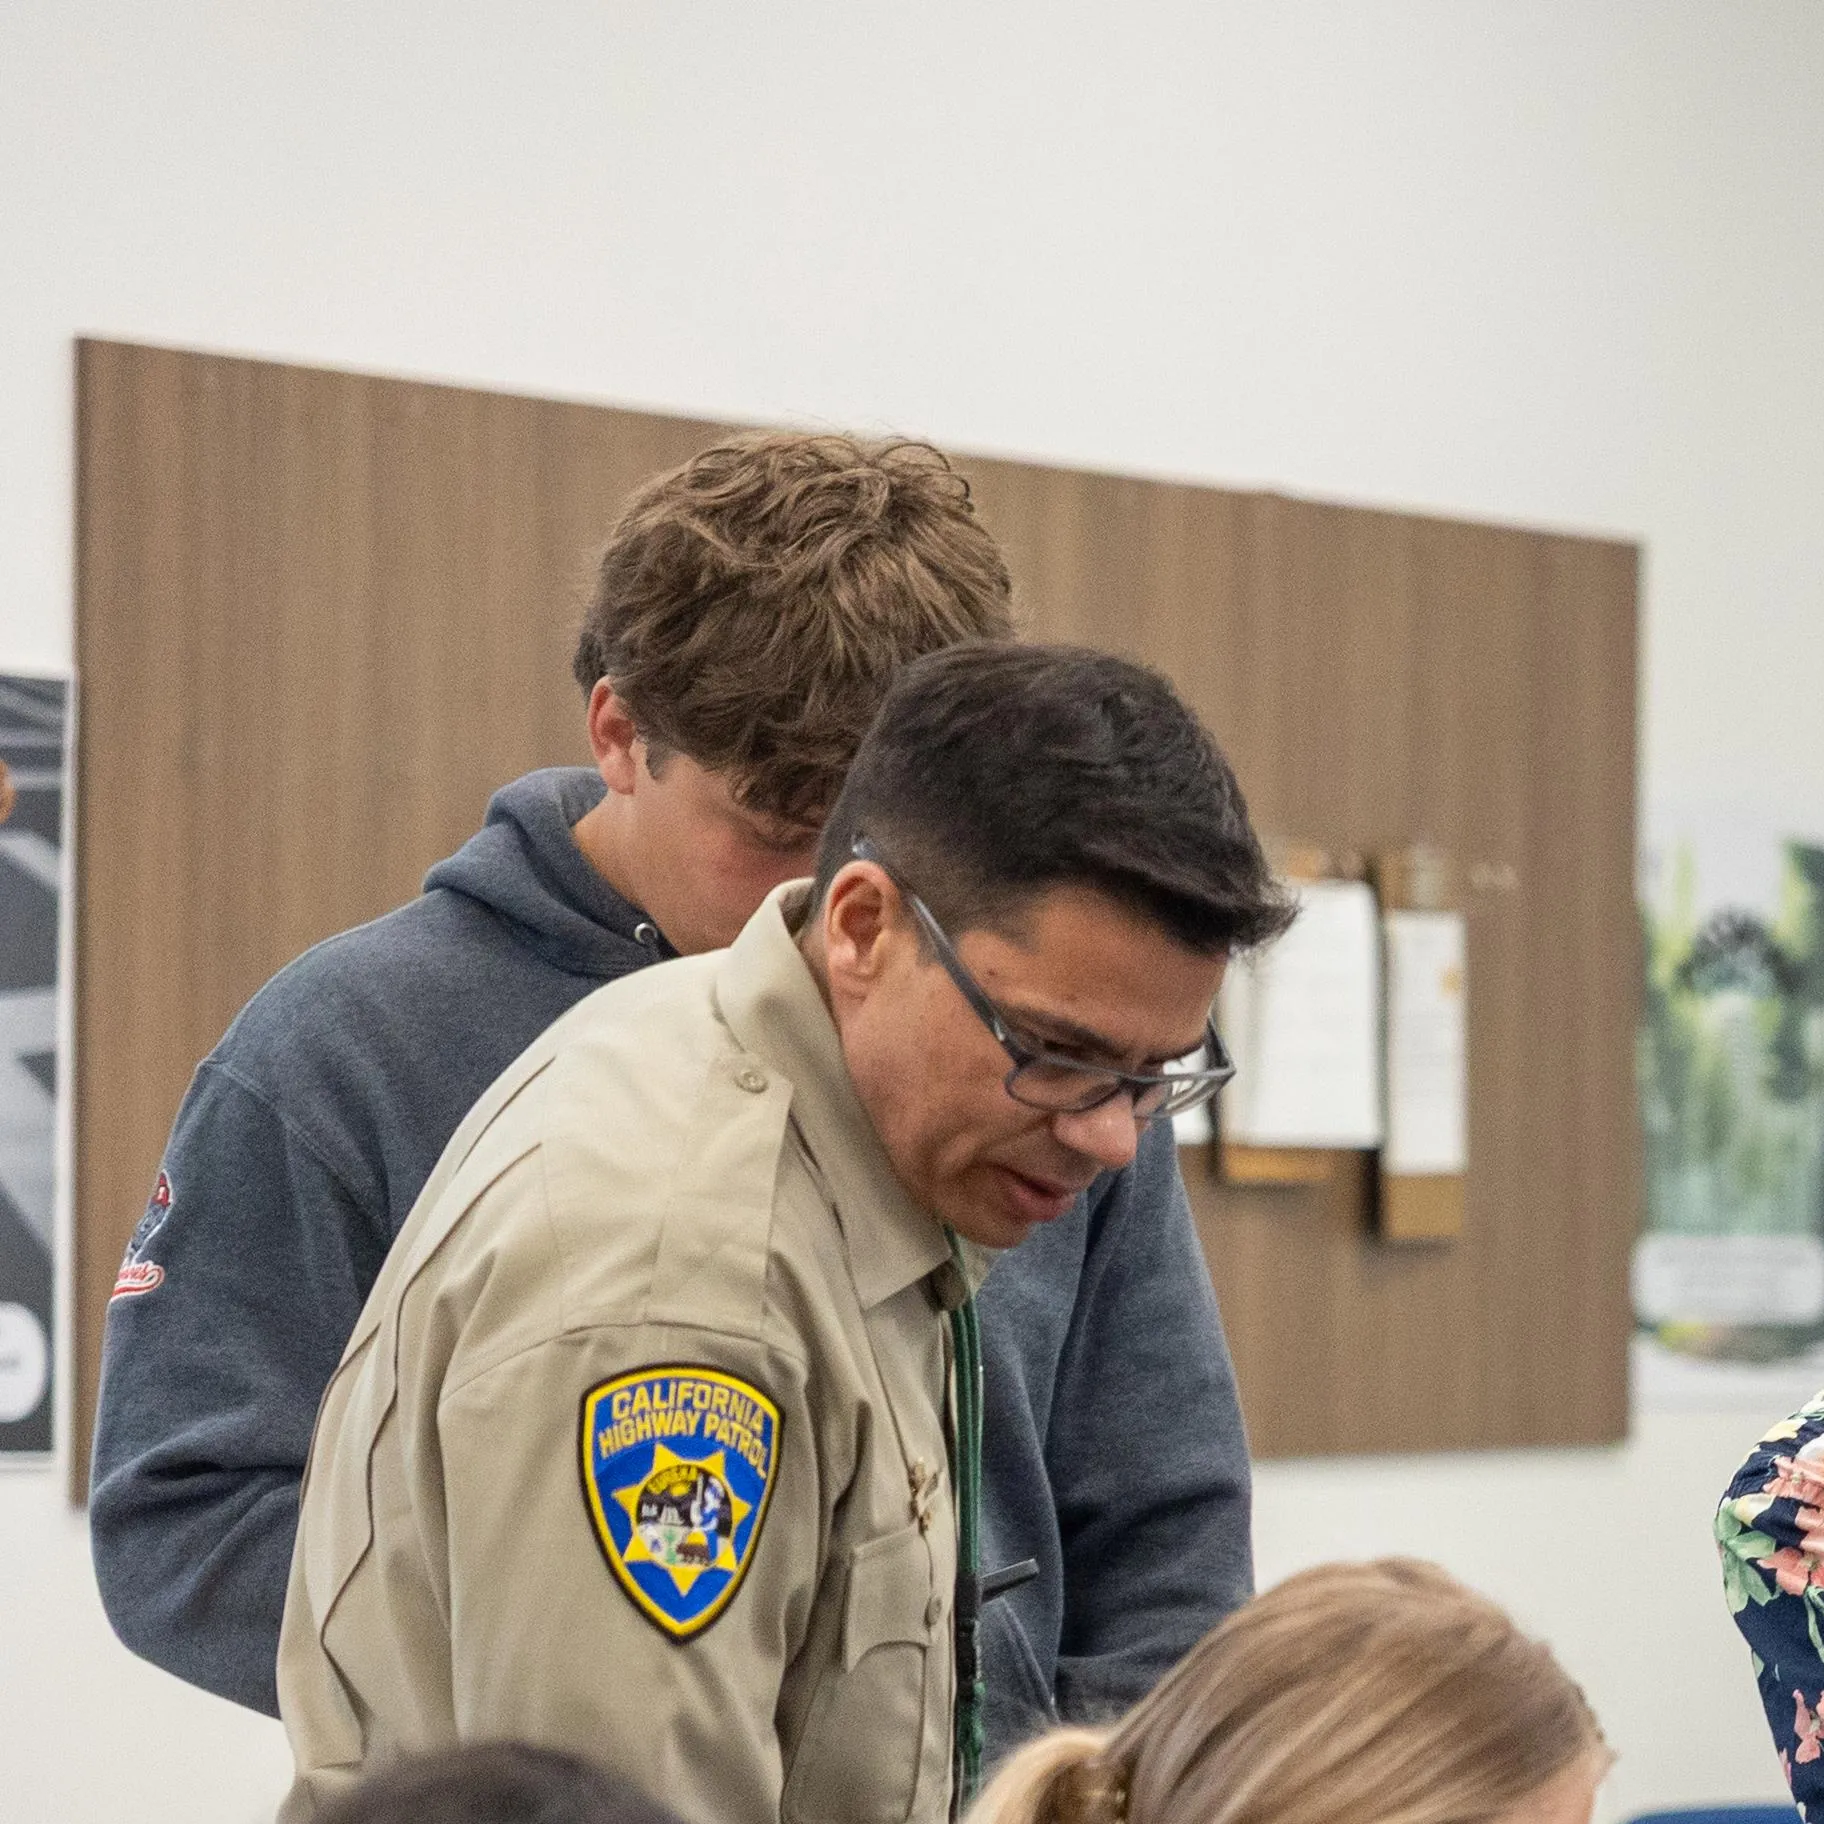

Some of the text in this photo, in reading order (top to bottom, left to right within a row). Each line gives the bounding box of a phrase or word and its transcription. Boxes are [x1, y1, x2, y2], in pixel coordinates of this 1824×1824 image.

[611, 1380, 764, 1434] CALIFORNIA
[598, 1410, 769, 1479] HIGHWAY PATROL
